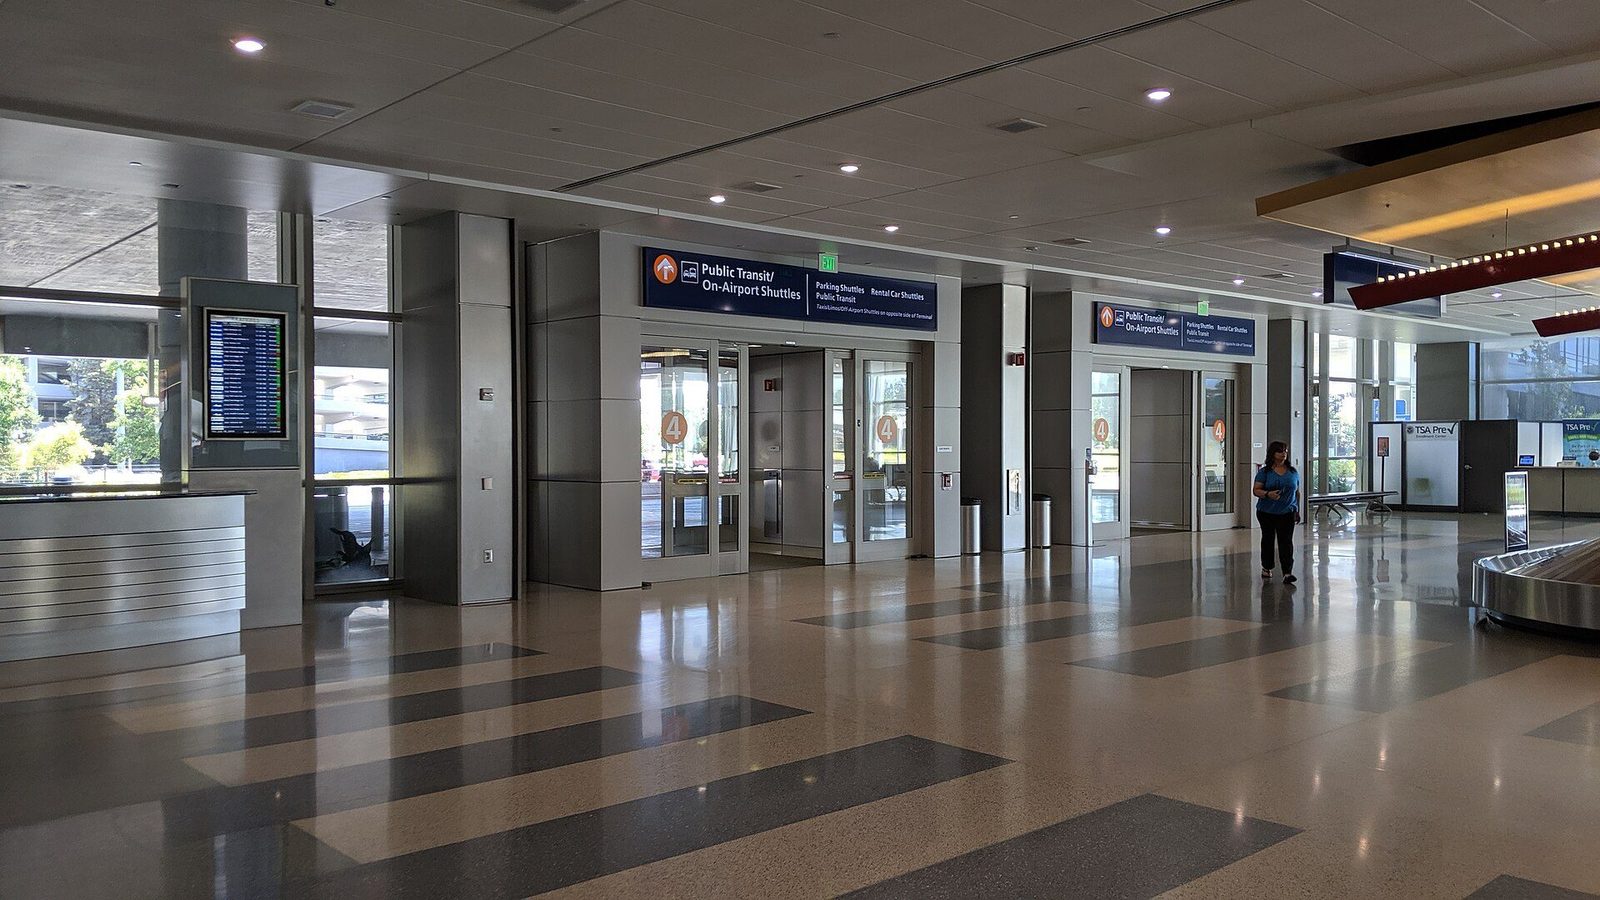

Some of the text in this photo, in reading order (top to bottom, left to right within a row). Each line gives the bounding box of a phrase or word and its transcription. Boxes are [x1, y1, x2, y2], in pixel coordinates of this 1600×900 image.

[702, 263, 774, 282] Public Transit/
[702, 279, 801, 300] On-Airport Shuttles
[816, 281, 865, 294] Parking Shuttles
[871, 288, 890, 297] Rental
[901, 291, 924, 301] Shuttles
[816, 292, 856, 303] Public Transit
[1125, 311, 1165, 323] Public Transit/
[1125, 322, 1179, 336] On-Airport Shuttles
[666, 416, 681, 440] 4
[881, 420, 893, 440] 4
[1097, 421, 1106, 439] 4
[1215, 421, 1223, 438] 4
[1415, 426, 1446, 434] TSA Pre
